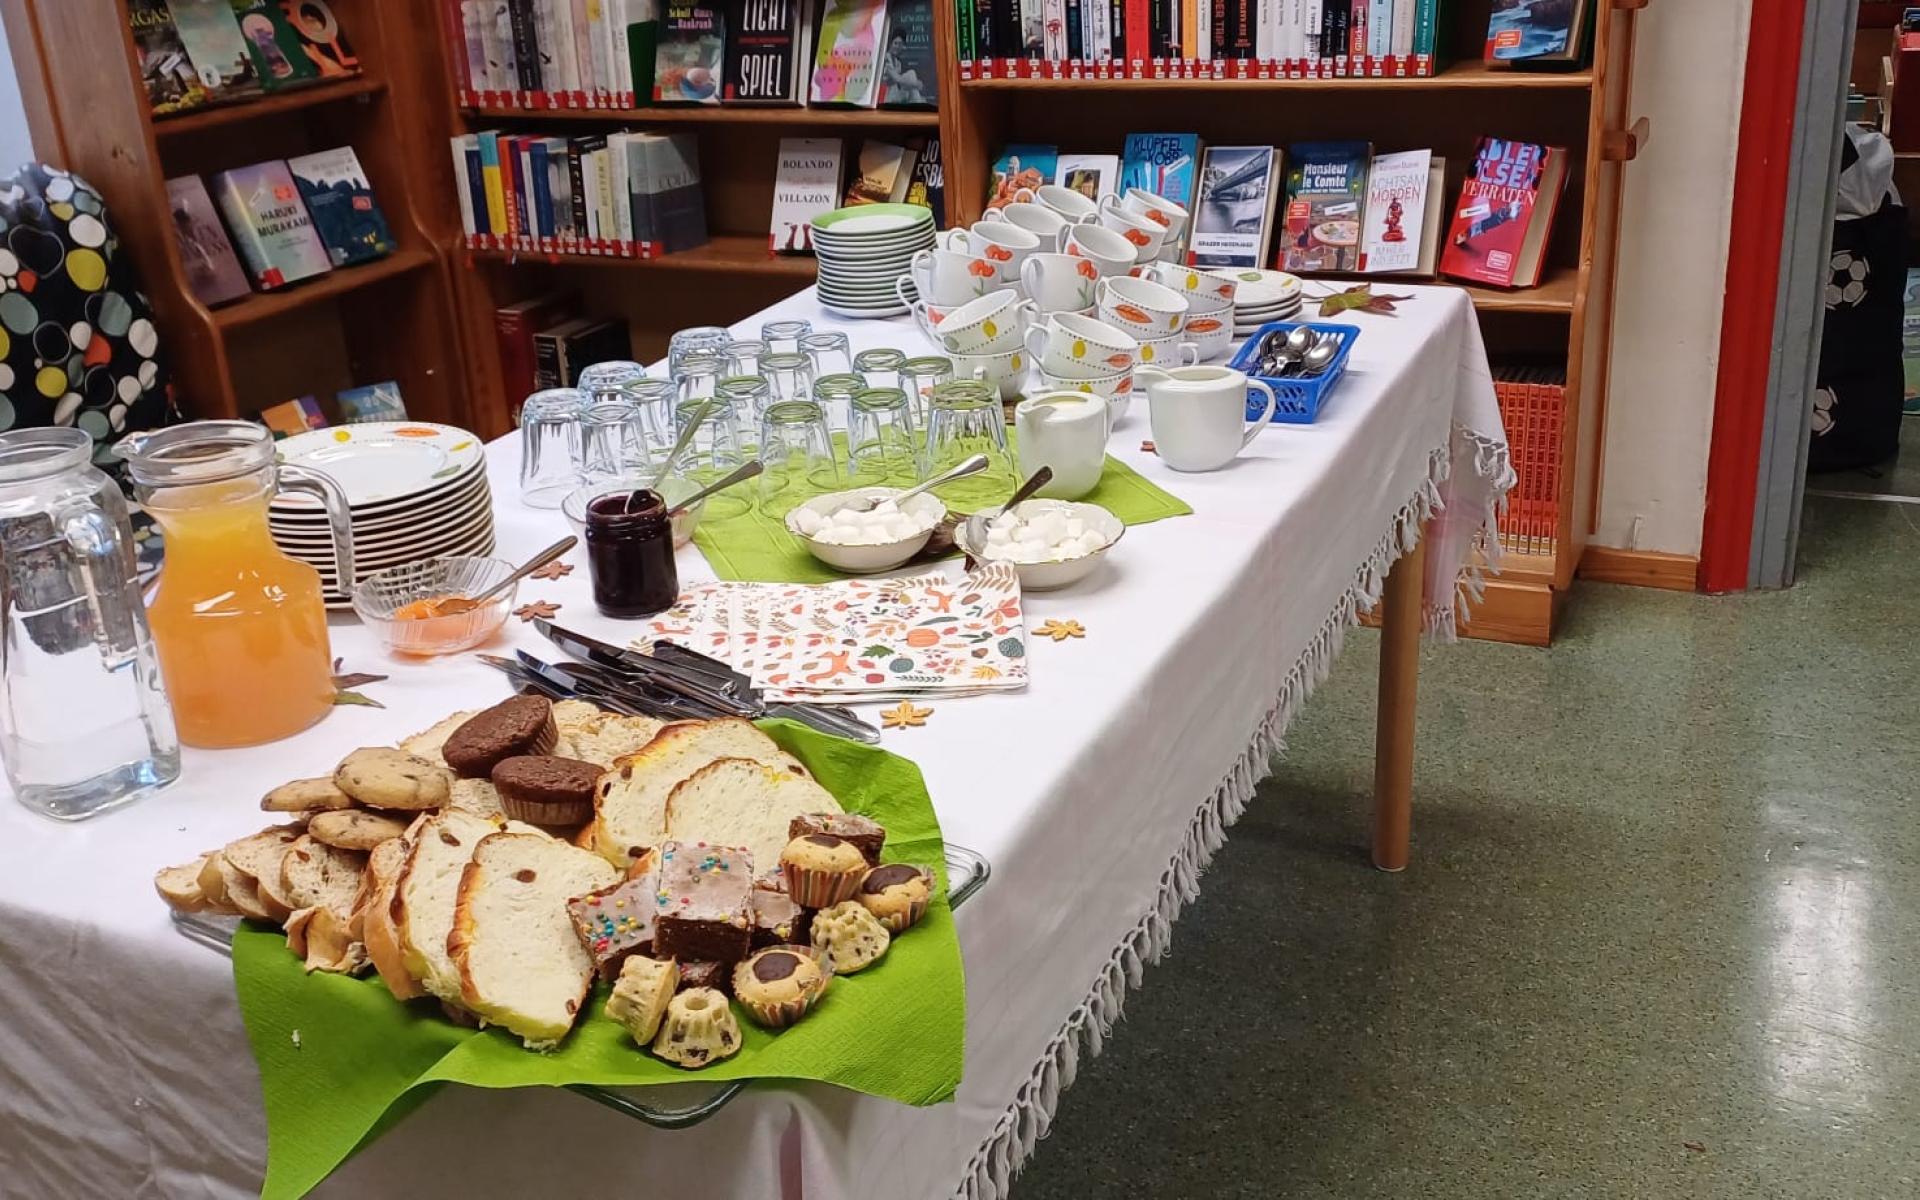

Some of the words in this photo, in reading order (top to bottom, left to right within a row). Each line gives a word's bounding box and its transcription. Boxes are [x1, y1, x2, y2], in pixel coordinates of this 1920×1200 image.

[739, 54, 783, 96] SPIEL
[921, 139, 940, 163] JO
[916, 163, 944, 190] ESB
[1303, 163, 1348, 175] Monsieur
[1302, 174, 1312, 188] le
[1314, 176, 1347, 188] Comte
[1371, 173, 1425, 188] ACHTSAM
[1370, 186, 1421, 203] MORDEN
[1463, 180, 1538, 206] VERRATEN
[260, 206, 298, 221] HARUKI
[257, 217, 311, 237] MURAKAMI
